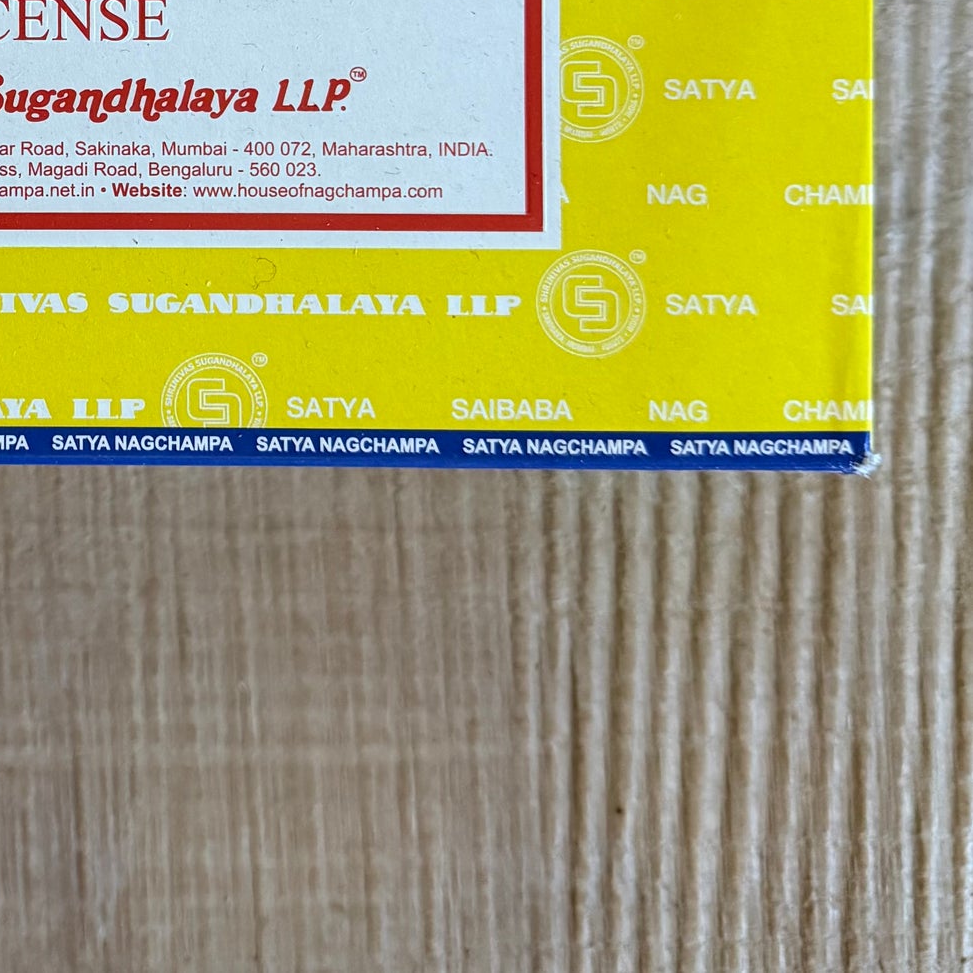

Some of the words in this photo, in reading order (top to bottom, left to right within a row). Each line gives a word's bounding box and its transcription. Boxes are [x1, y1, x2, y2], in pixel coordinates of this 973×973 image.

[665, 79, 755, 100] SATYA
[20, 140, 68, 158] Road,
[75, 140, 155, 158] Sakinaka,
[161, 140, 227, 157] Mumbai
[243, 141, 275, 157] 400
[280, 141, 315, 159] 072,
[322, 141, 432, 159] Maharashtra,
[439, 141, 493, 157] INDIA.
[28, 161, 88, 181] Magadi
[94, 161, 142, 179] Road,
[148, 161, 233, 181] Bengaluru
[249, 161, 280, 177] 560
[285, 161, 321, 177] 023.
[111, 182, 187, 198] Website:
[193, 182, 443, 202] www.houseofnagchampa.com
[648, 184, 707, 205] NAG
[108, 293, 425, 315] SUGANDHALAYA
[447, 295, 521, 316] LLP
[666, 294, 757, 315] SATYA
[73, 399, 145, 420] LLP
[287, 397, 375, 418] SATYA
[452, 399, 572, 420] SAIBABA
[649, 400, 708, 422] NAG
[53, 435, 110, 450] SATYA
[116, 436, 233, 451] NAGCHAMPA
[257, 437, 314, 451] SATYA
[320, 437, 439, 452] NAGCHAMPA
[464, 438, 522, 453] SATYA
[528, 439, 646, 454] NAGCHAMPA
[671, 439, 729, 454] SATYA
[735, 439, 854, 455] NAGCHAMPA
